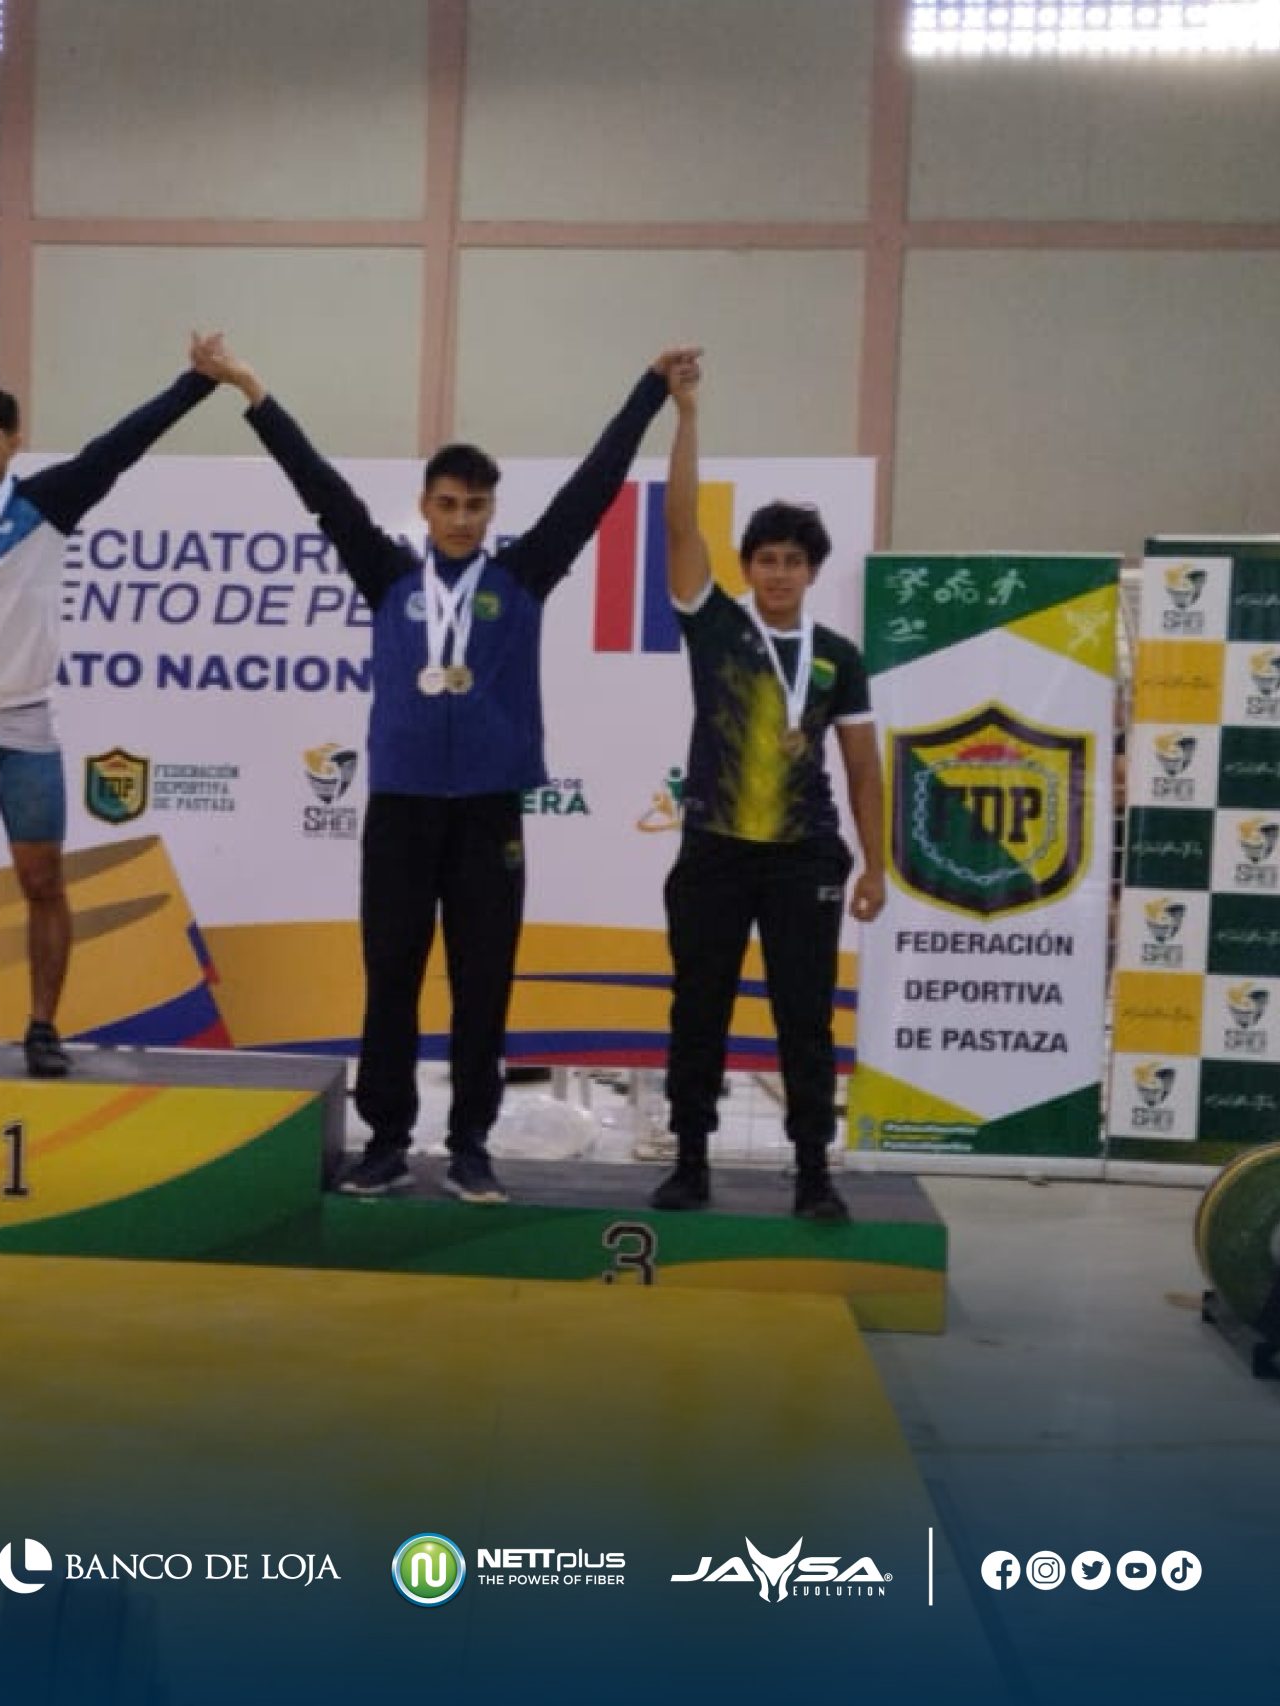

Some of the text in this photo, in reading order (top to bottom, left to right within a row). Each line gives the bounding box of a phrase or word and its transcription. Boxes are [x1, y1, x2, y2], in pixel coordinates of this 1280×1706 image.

[213, 583, 294, 625] DE
[156, 653, 372, 692] NACION
[522, 790, 590, 815] ERA
[896, 929, 1074, 957] FEDERACIÓN
[905, 979, 1064, 1005] DEPORTIVA
[896, 1027, 1069, 1054] DE PASTAZA
[1, 1122, 31, 1200] 1
[601, 1222, 658, 1285] 3
